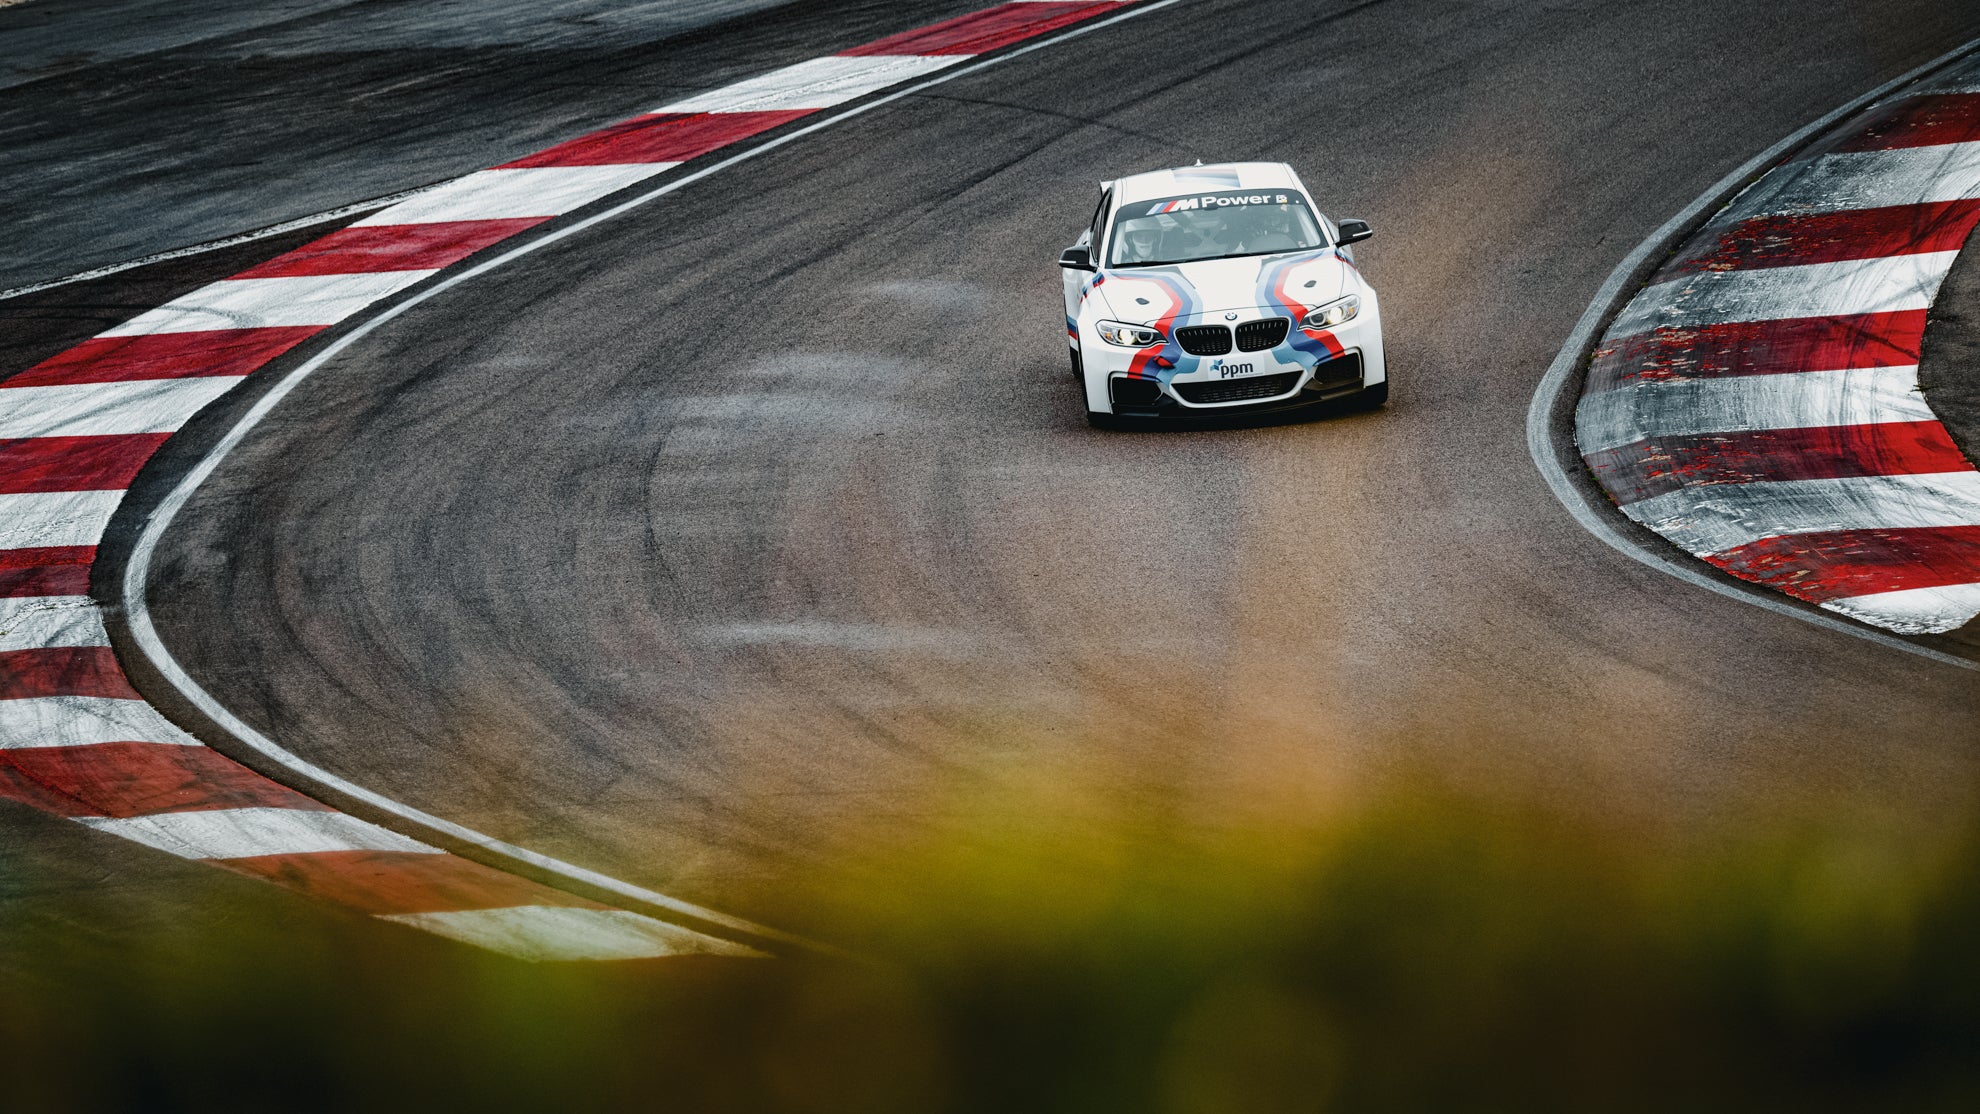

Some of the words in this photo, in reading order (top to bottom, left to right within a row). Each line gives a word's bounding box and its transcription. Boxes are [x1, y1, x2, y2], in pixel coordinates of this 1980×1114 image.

[1169, 198, 1199, 212] M
[1201, 195, 1271, 208] Power
[1221, 363, 1254, 378] ppm
